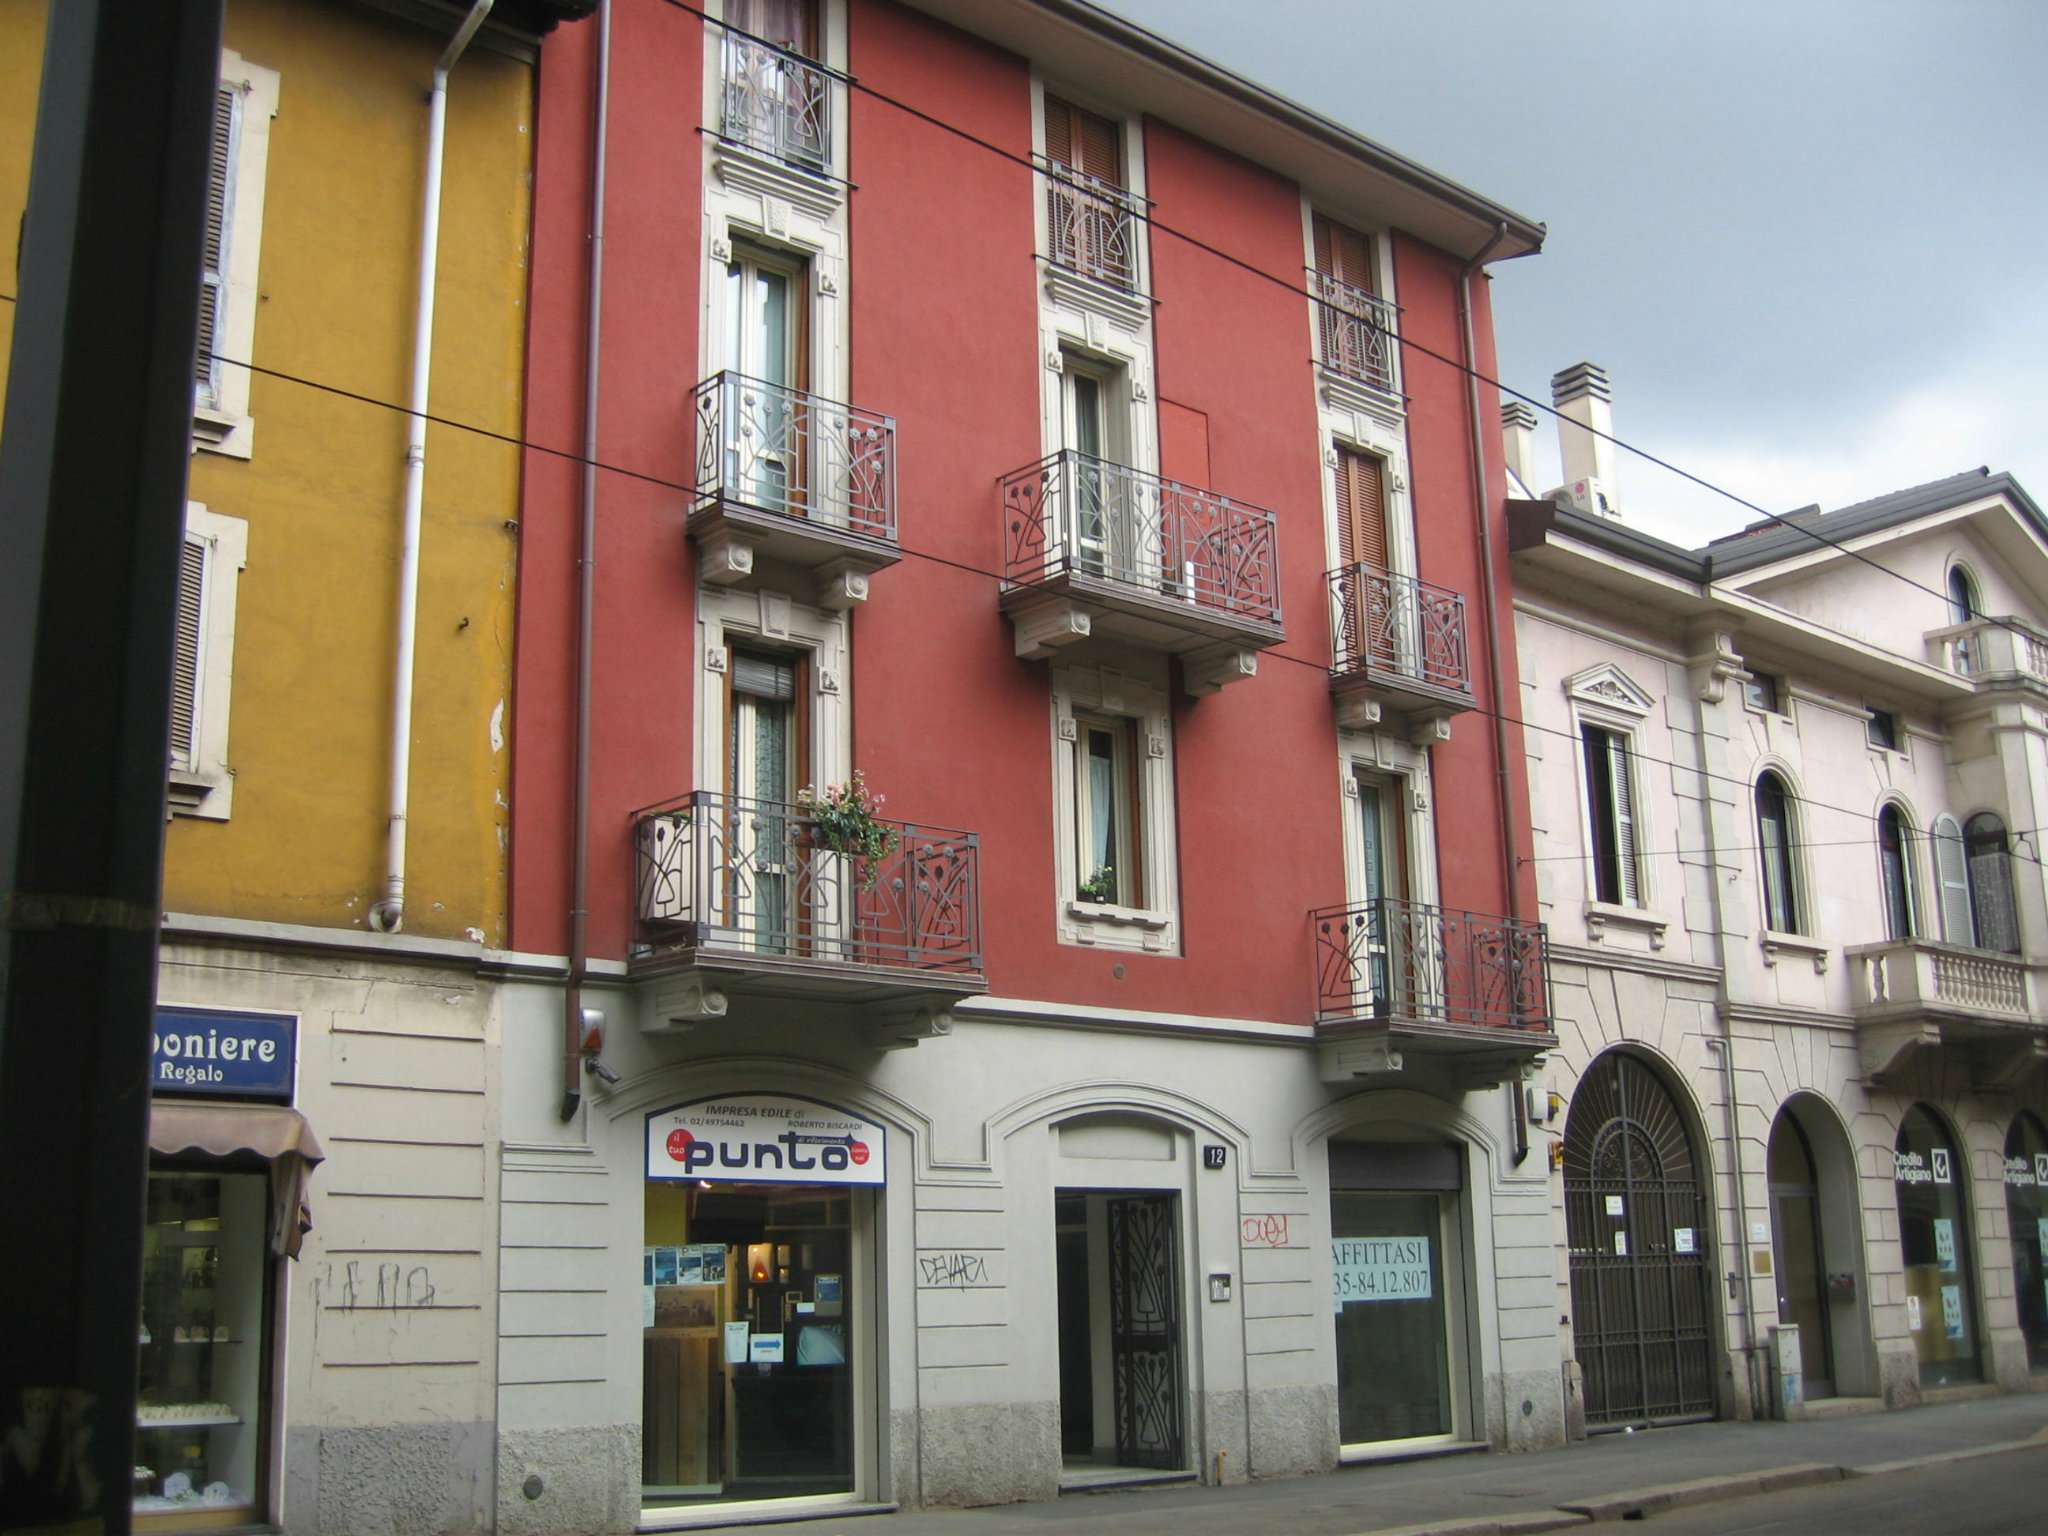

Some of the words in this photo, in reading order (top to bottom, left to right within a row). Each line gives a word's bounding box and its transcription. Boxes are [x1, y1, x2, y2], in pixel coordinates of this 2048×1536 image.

[154, 1029, 276, 1062] oniere
[160, 1061, 223, 1084] Regalo
[705, 1105, 757, 1117] IMPRESA
[760, 1107, 793, 1119] EDILE
[684, 1131, 849, 1174] punto
[1210, 1148, 1224, 1164] 12
[1331, 1241, 1424, 1265] AFFITTASI
